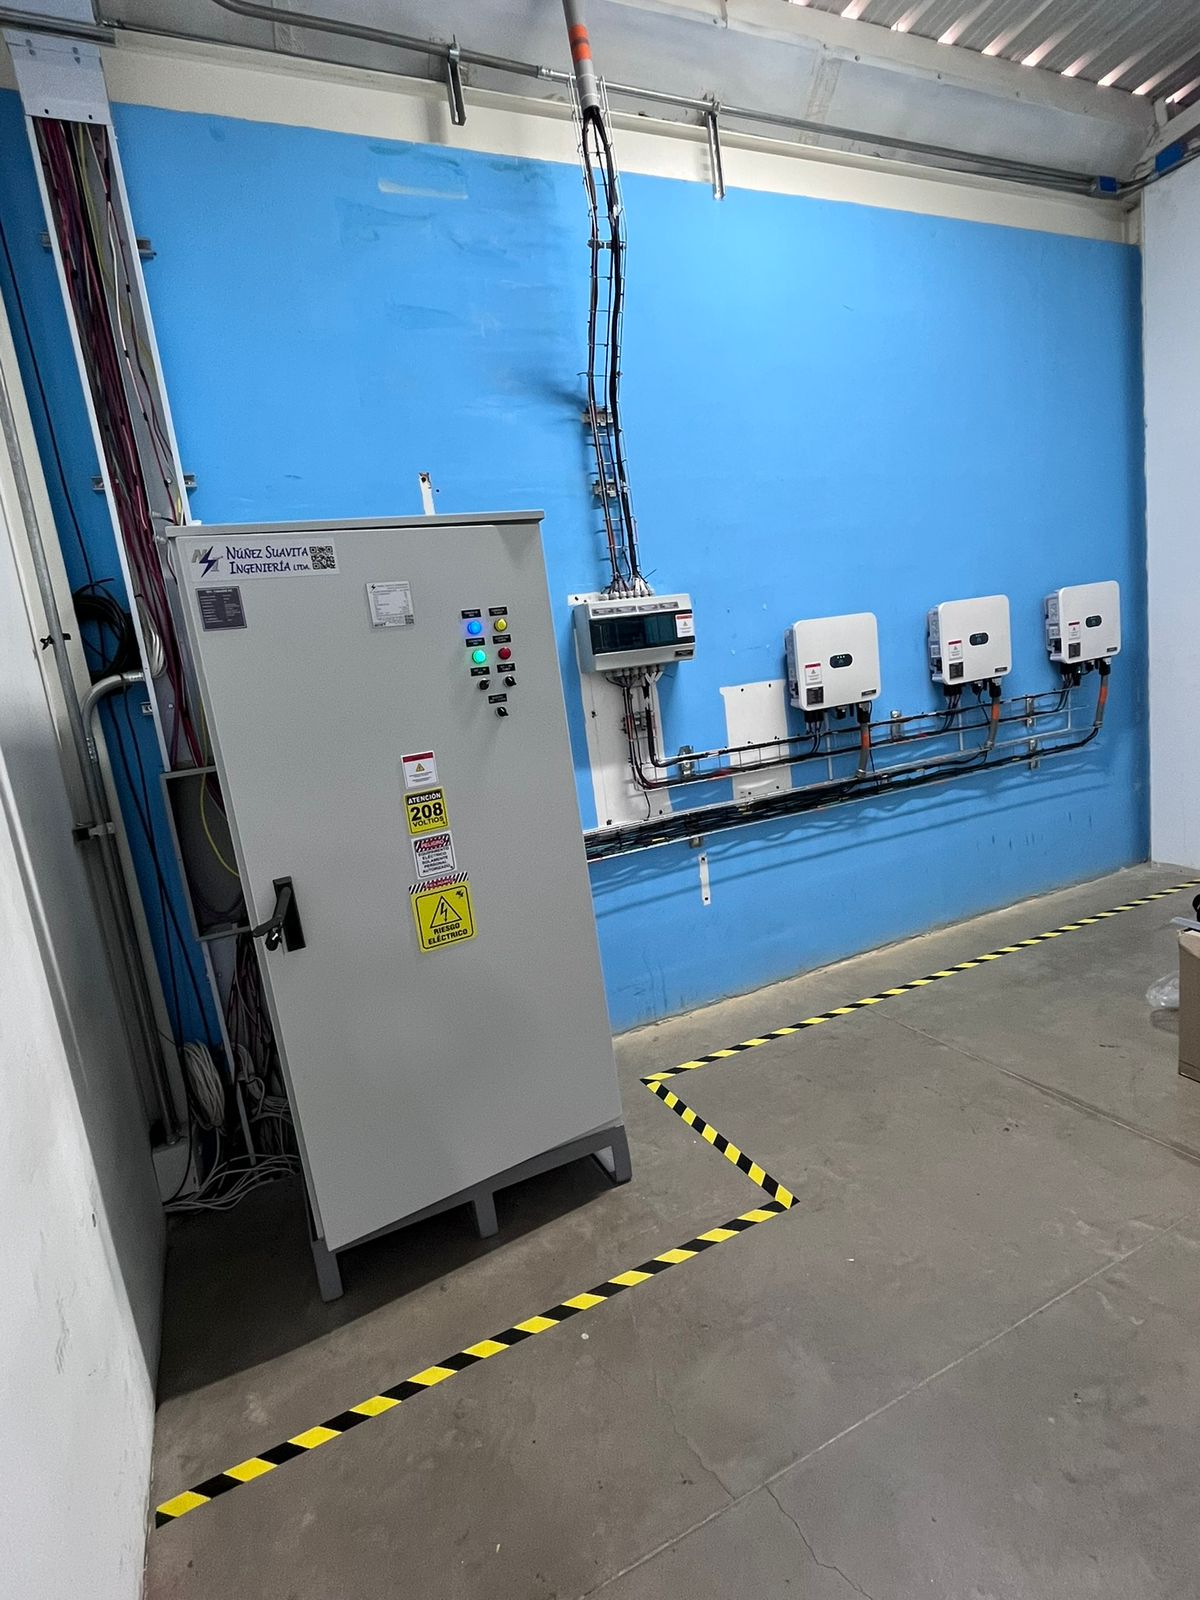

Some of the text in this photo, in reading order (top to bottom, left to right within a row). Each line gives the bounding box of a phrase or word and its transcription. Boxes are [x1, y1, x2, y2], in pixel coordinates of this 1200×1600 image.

[225, 545, 309, 560] NÚÑEZ SUAVITA
[230, 561, 291, 575] INGENIERÍA
[410, 802, 443, 821] 208
[413, 817, 444, 828] VOLTIOS
[433, 922, 460, 935] RIESGO
[428, 928, 468, 945] ELÉCTRICO
